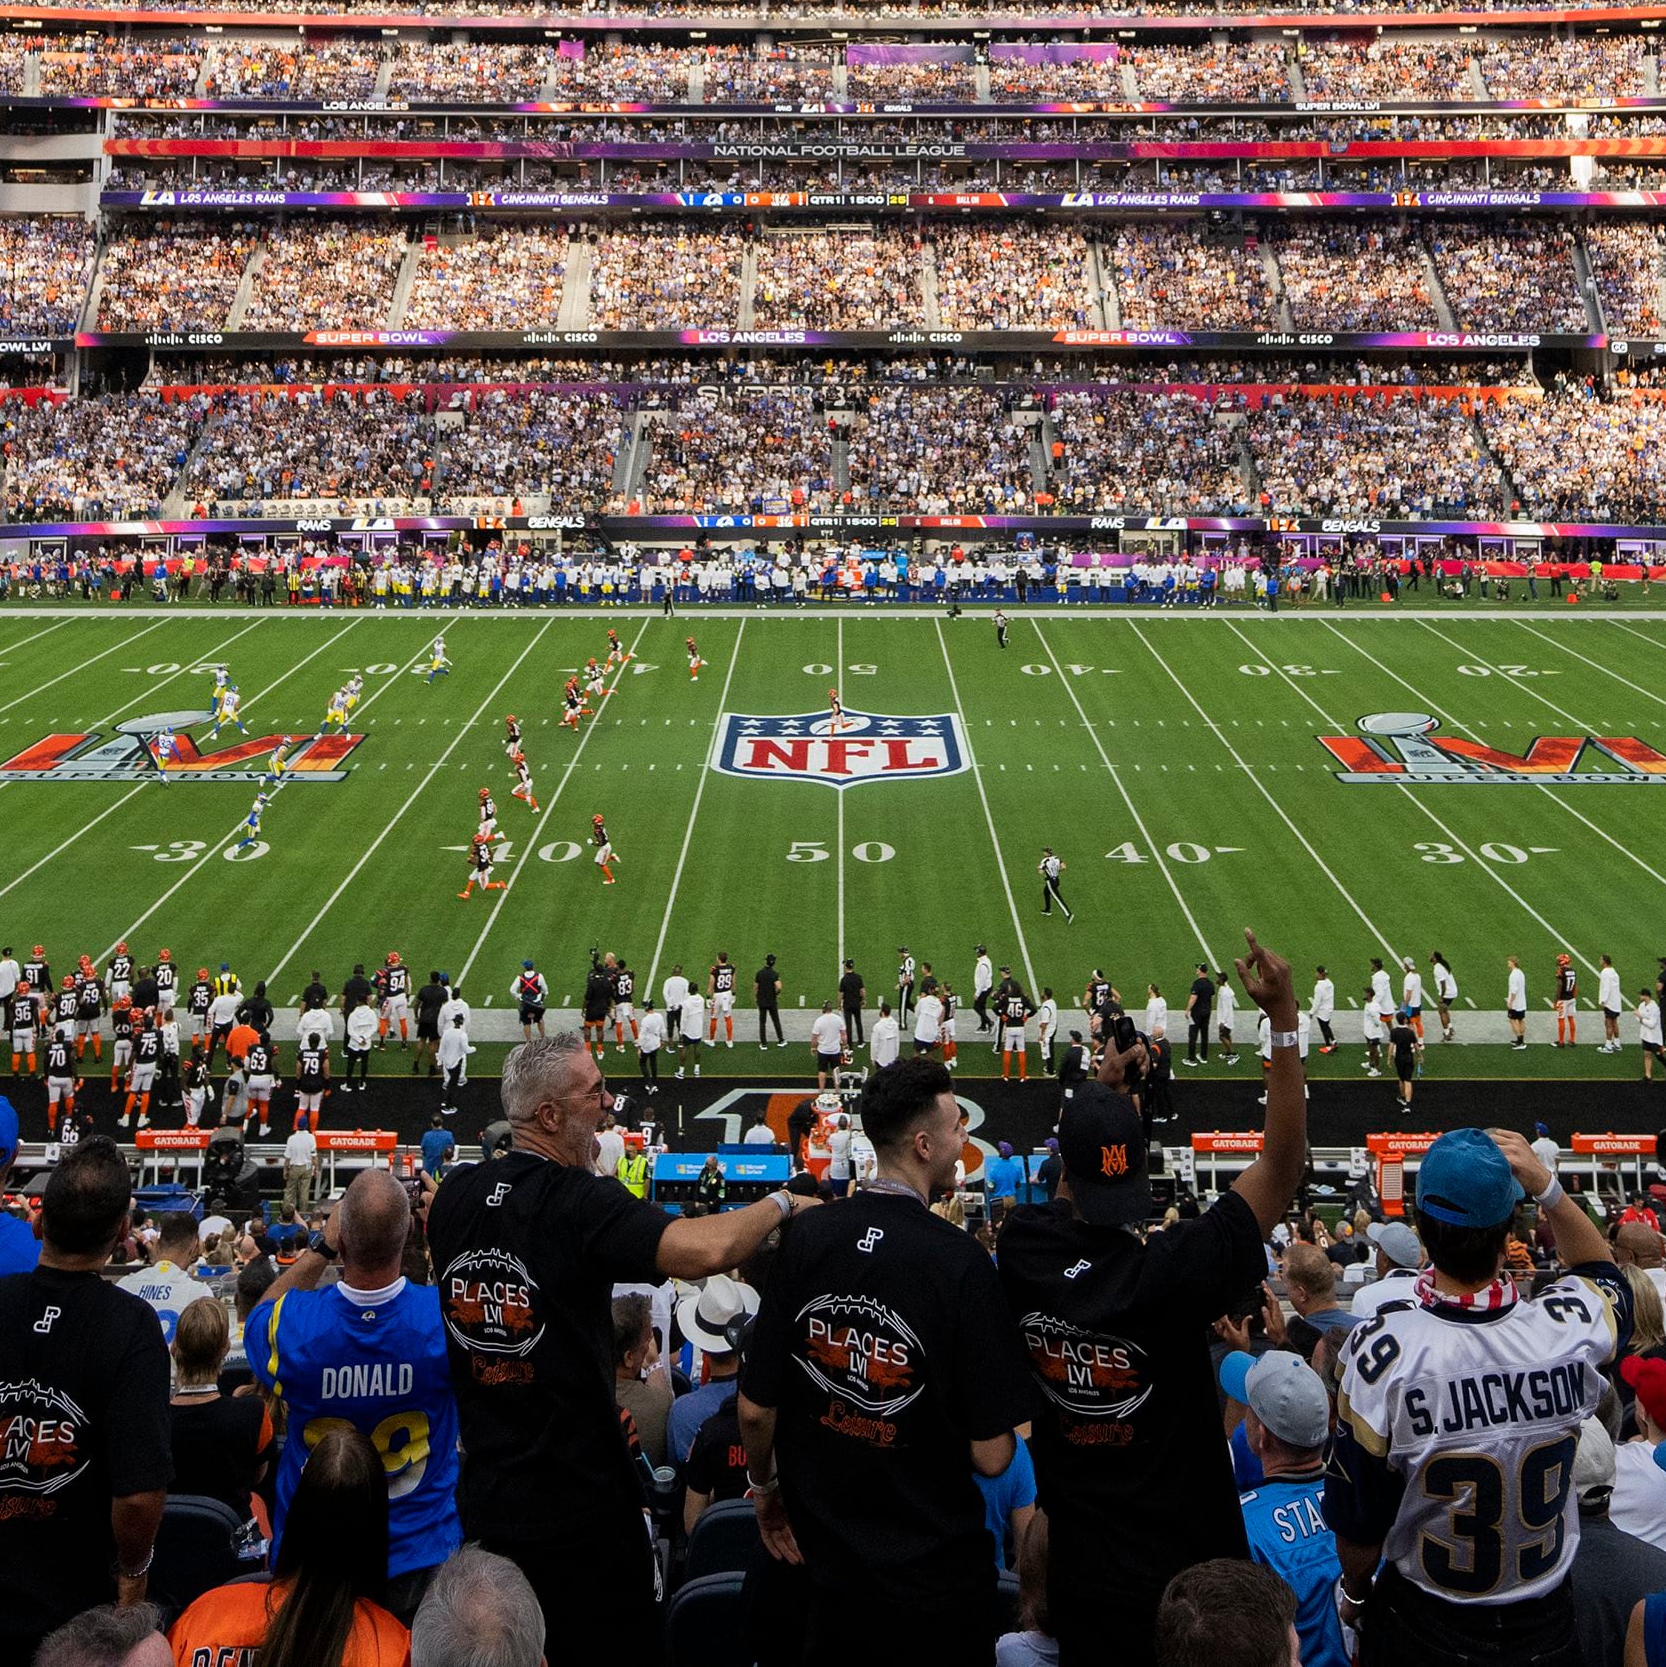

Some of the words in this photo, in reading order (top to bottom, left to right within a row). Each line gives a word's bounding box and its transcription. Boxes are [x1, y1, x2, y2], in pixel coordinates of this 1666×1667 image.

[713, 143, 797, 157] NATIONAL
[801, 143, 891, 157] FOOTBALL
[894, 143, 967, 157] LEAGUE
[1425, 333, 1461, 346] LOS
[1464, 333, 1541, 346] ANGELES
[742, 738, 939, 773] NFL
[1377, 773, 1515, 785] SUPER
[151, 839, 271, 863] 30
[784, 840, 897, 865] 50
[1104, 840, 1213, 865] 40
[1412, 841, 1531, 866] 30
[25, 969, 39, 984] 91
[113, 964, 130, 979] 22
[156, 970, 172, 985] 20
[716, 974, 732, 989] 89
[390, 976, 406, 992] 94
[1565, 975, 1575, 991] 17
[1007, 1001, 1023, 1018] 46
[140, 1037, 157, 1054] 75
[250, 1053, 266, 1070] 63
[1211, 1138, 1259, 1150] GATORADE
[1589, 1140, 1642, 1152] GATORADE
[139, 1284, 172, 1301] HINES
[450, 1277, 530, 1308] PLACES
[483, 1303, 503, 1325] LVI
[808, 1316, 909, 1367] PLACES
[1024, 1330, 1131, 1370] PLACES
[1347, 1313, 1402, 1385] 39
[848, 1351, 868, 1380] LVI
[1065, 1362, 1094, 1386] LVI
[320, 1362, 414, 1399] DONALD
[1403, 1360, 1587, 1438] S.JACKSON
[5, 1439, 30, 1461] LVI
[1415, 1434, 1582, 1598] 39
